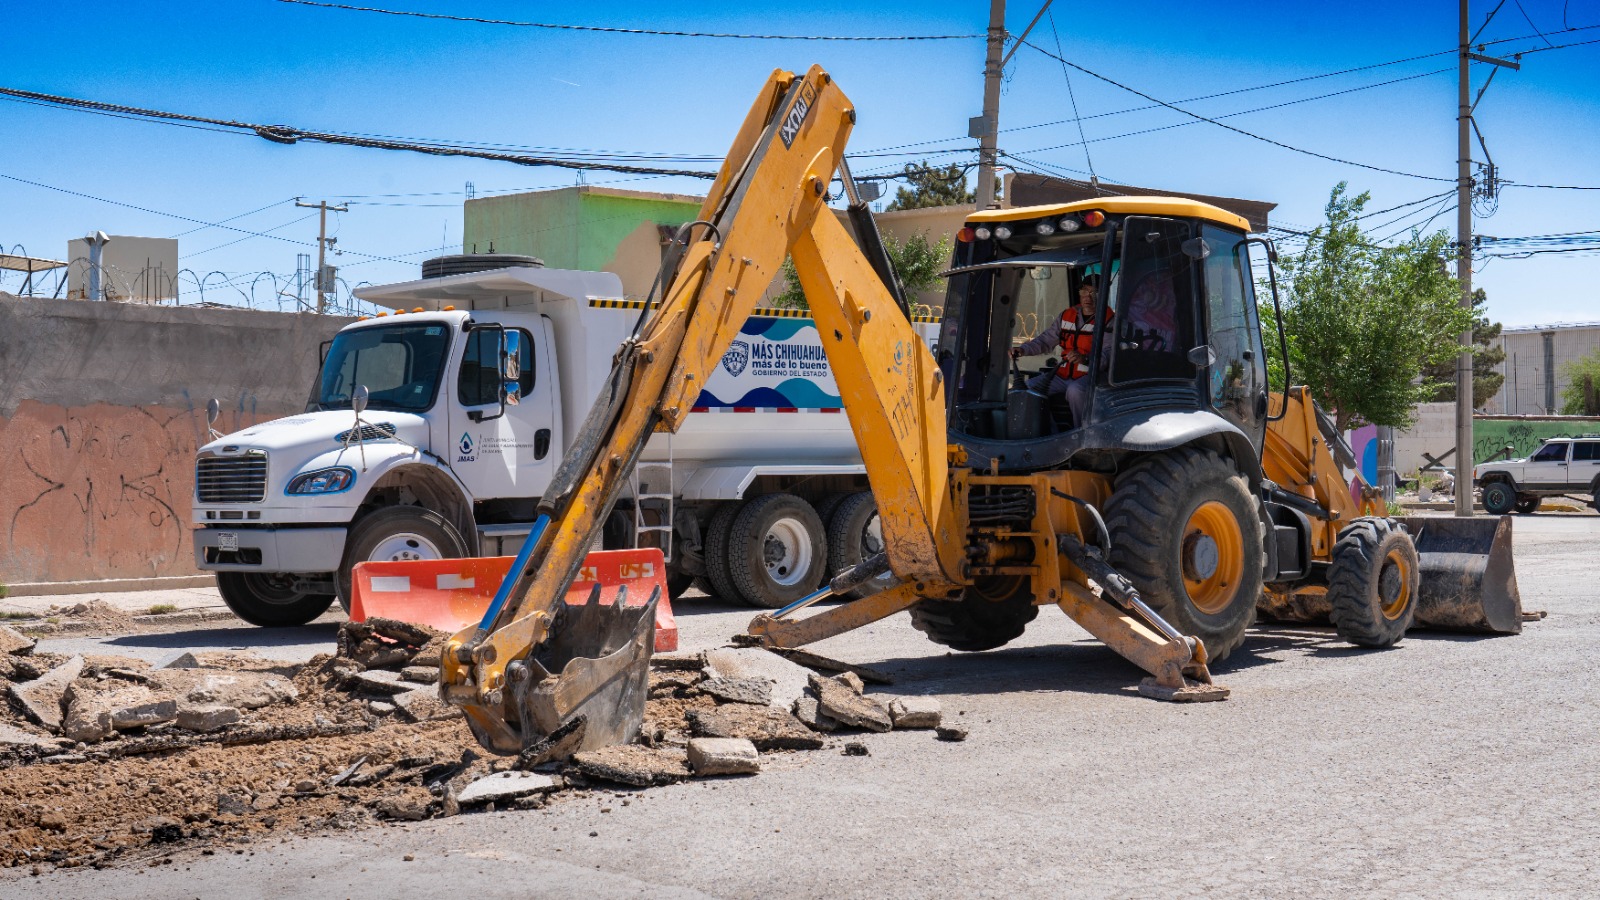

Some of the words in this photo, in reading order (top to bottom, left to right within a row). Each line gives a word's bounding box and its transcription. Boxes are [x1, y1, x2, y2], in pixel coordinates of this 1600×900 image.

[753, 340, 773, 360] MÁS
[776, 344, 827, 361] CHIHUAHUA
[752, 359, 772, 368] más
[775, 360, 787, 369] de
[788, 360, 797, 369] lo
[799, 361, 827, 370] bueno
